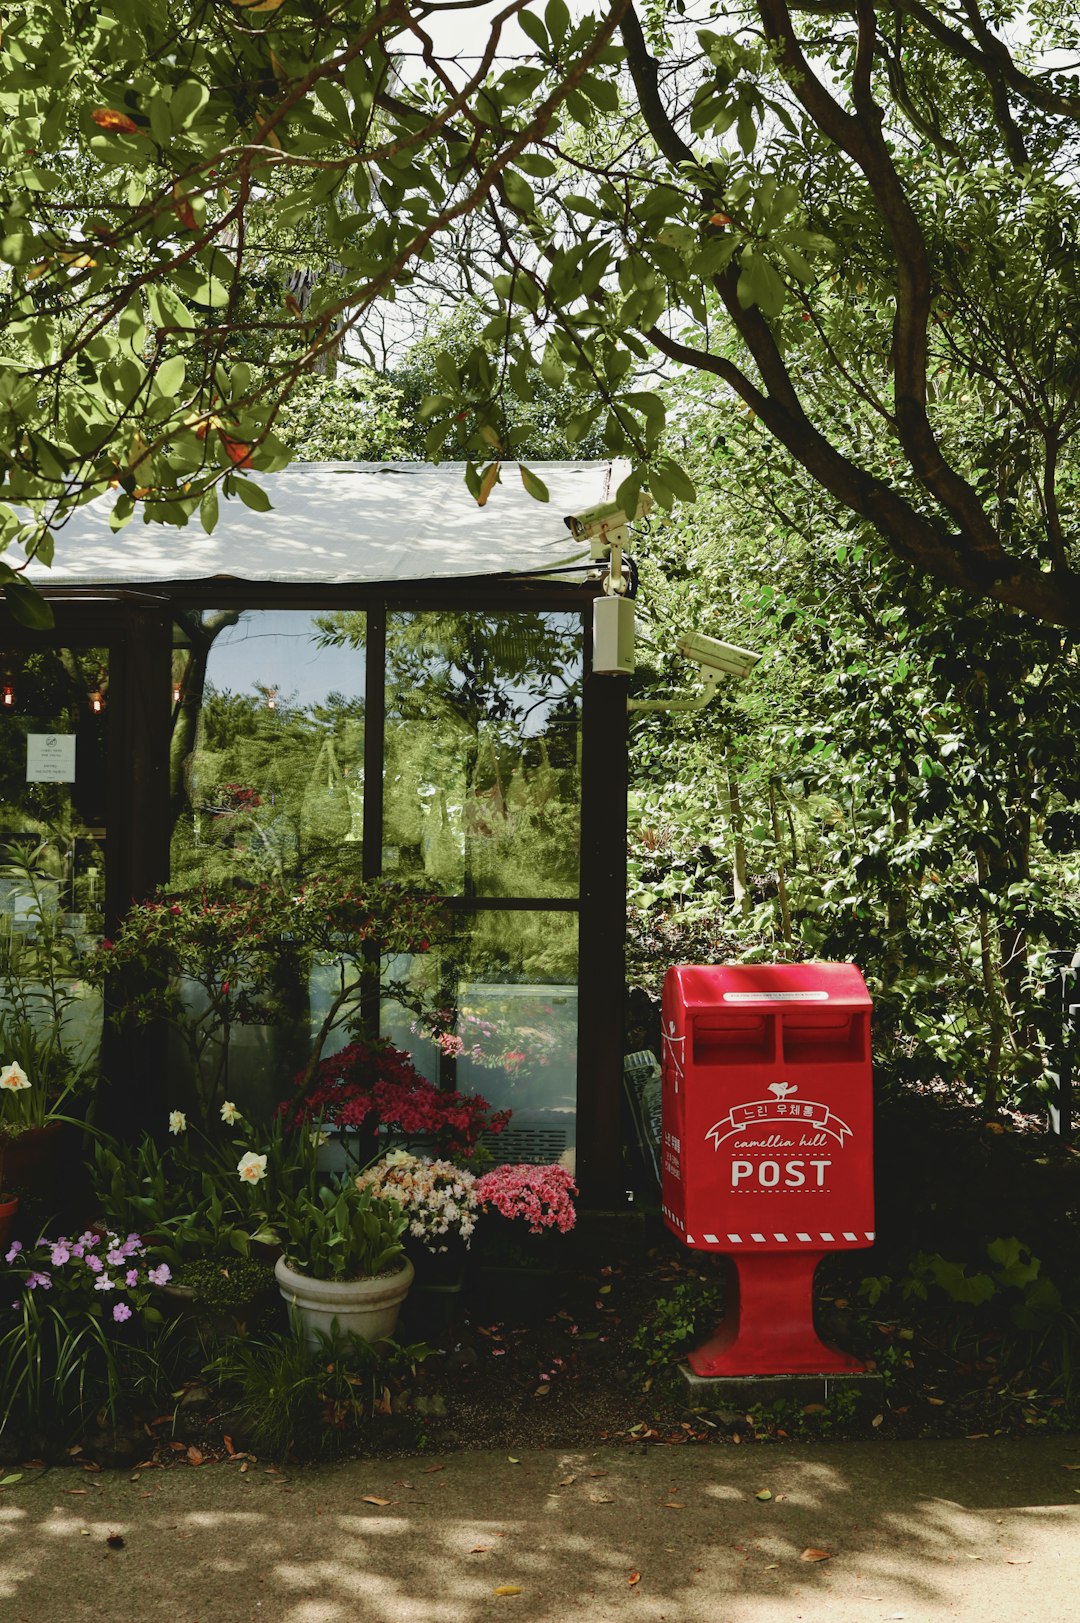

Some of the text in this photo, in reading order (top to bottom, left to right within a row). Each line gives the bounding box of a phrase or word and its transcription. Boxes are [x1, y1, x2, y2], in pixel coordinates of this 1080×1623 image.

[744, 1104, 814, 1119] 느린 우체통
[734, 1133, 828, 1149] camellia hill
[731, 1160, 832, 1187] POST
